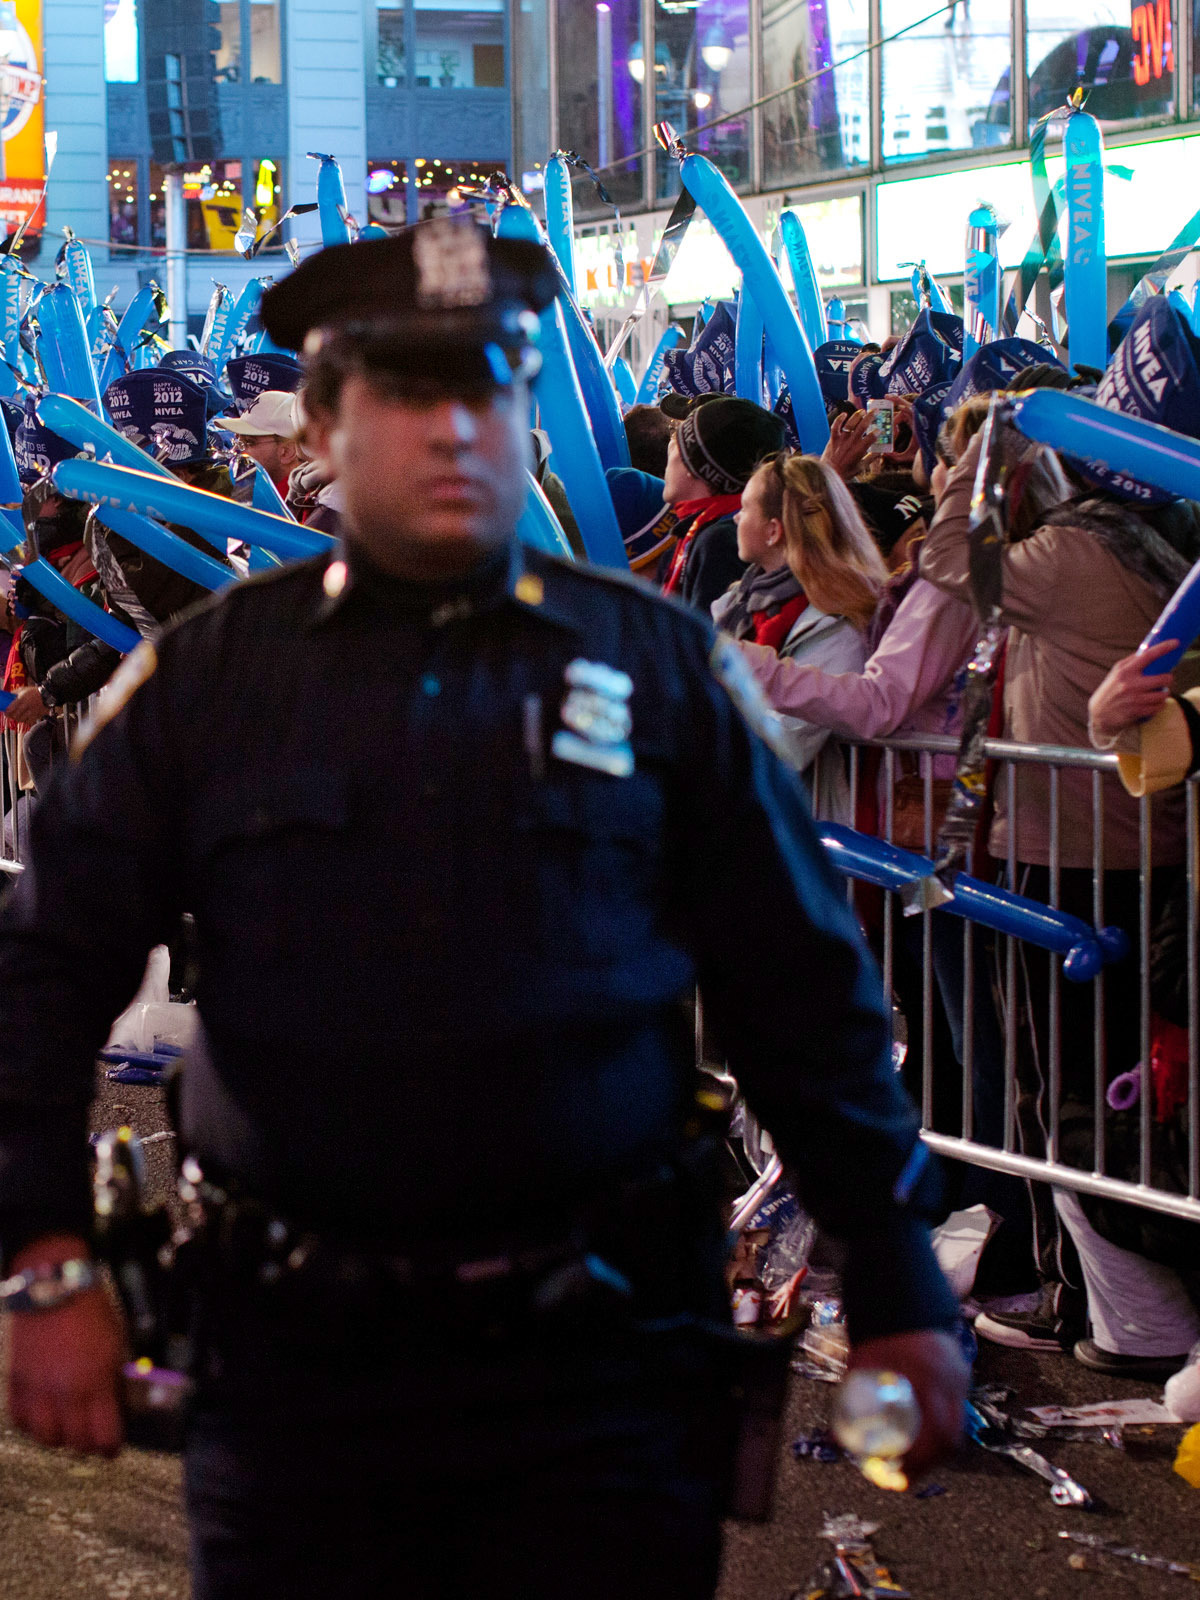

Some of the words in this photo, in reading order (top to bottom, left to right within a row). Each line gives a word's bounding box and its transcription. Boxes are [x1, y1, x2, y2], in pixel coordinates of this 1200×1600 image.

[560, 171, 569, 222] NIVEA
[1072, 163, 1092, 244] NIVEA
[71, 249, 89, 295] NIVEA
[6, 275, 19, 328] NIVEA
[208, 313, 228, 360] NIVEA
[225, 311, 252, 349] NIVEA
[1133, 319, 1168, 403] NIVEA
[243, 370, 270, 385] 2012
[109, 394, 130, 407] 2012
[153, 391, 183, 403] 2012
[155, 407, 184, 416] NIVEA
[112, 410, 132, 420] NIVEA
[63, 487, 139, 513] NIVEA
[1111, 475, 1152, 499] 2012
